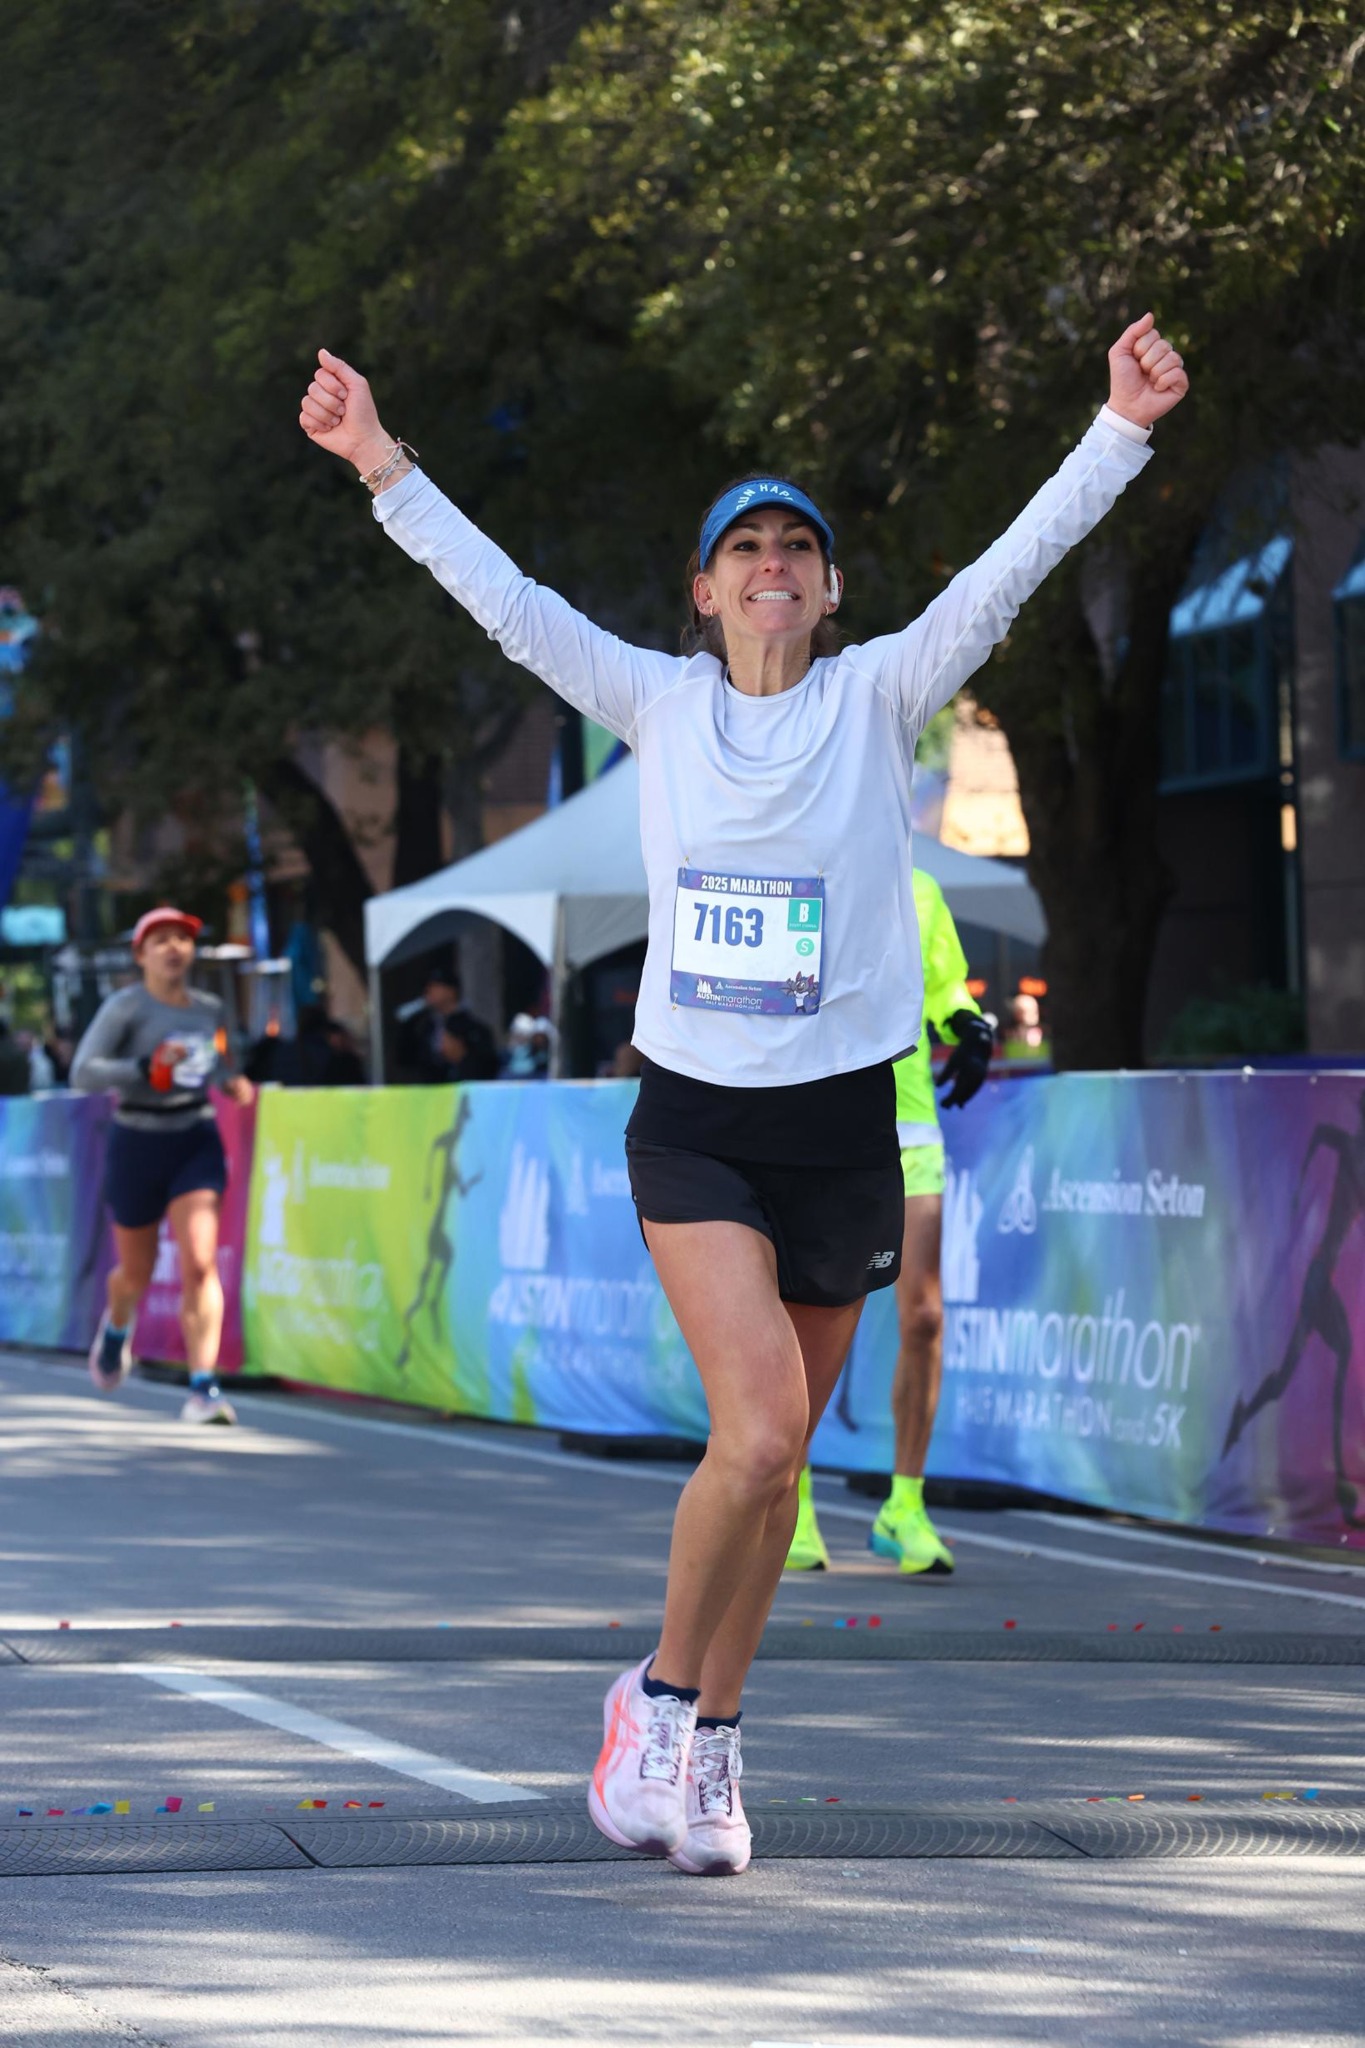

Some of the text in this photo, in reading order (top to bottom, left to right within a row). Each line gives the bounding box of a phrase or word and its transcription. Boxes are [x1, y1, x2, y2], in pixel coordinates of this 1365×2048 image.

[736, 484, 794, 511] RUN HAP
[702, 875, 793, 896] 2025 MARATHON
[694, 902, 764, 948] 7163
[799, 902, 810, 923] B
[800, 941, 811, 953] S
[696, 992, 764, 1005] AUSTINmarathon
[1042, 1167, 1206, 1218] Ascension Seton
[942, 1288, 1192, 1394] USTINmarathon
[995, 1387, 1113, 1441] MARATHON
[1148, 1402, 1188, 1449] 5K
